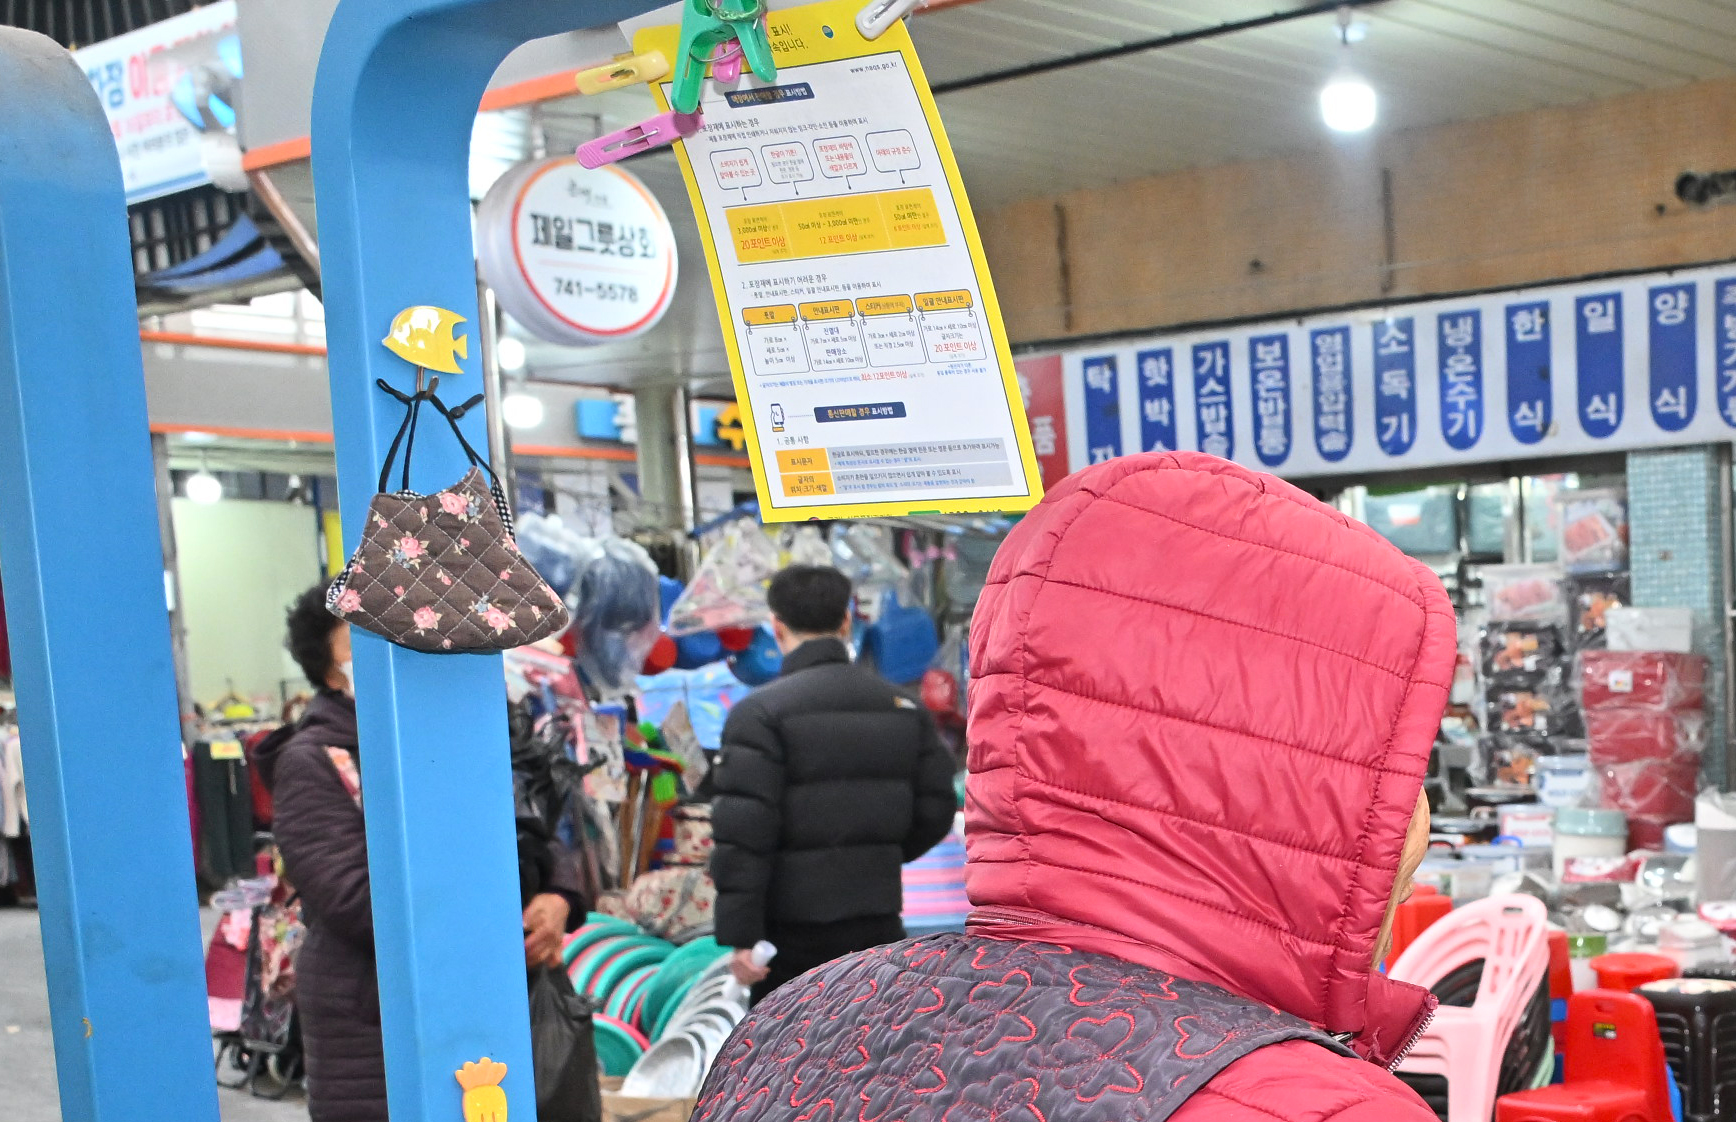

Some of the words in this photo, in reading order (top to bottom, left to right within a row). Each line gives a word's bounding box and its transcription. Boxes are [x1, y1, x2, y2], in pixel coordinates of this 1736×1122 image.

[529, 213, 657, 258] 제일그릇상회
[554, 277, 639, 303] 741-5578
[942, 342, 963, 352] 포인트
[962, 341, 978, 351] 이상
[1254, 341, 1290, 457] 보온밥통
[1377, 325, 1413, 445] 소독기
[1511, 309, 1546, 431] 한식
[1582, 300, 1618, 427] 일식
[1653, 292, 1689, 421] 양식
[857, 407, 871, 416] 경우
[870, 405, 894, 415] 표시방법
